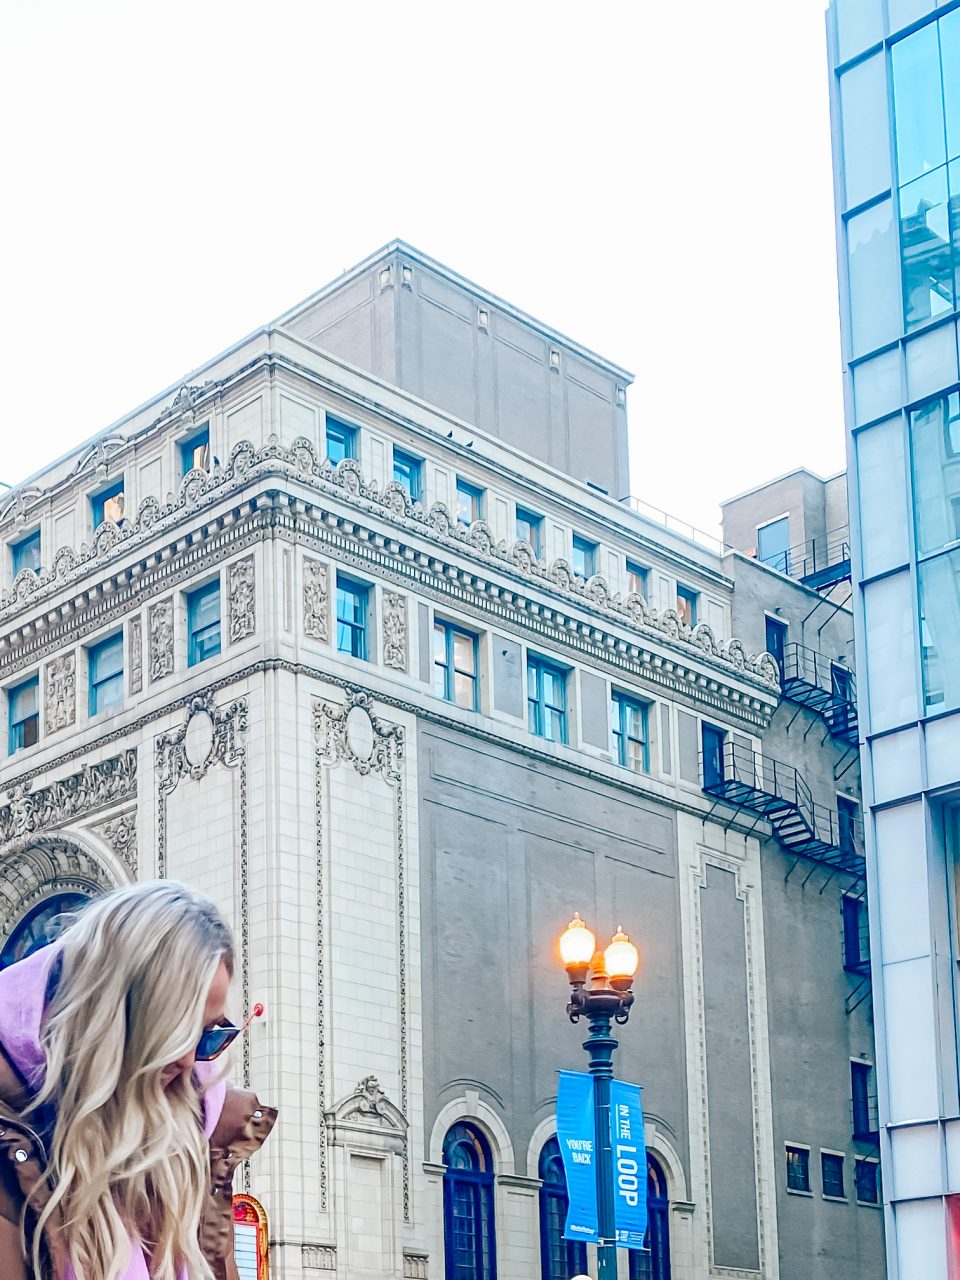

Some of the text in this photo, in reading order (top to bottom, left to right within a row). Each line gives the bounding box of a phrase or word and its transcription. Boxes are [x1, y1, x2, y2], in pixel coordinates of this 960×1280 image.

[566, 1138, 594, 1152] YOU'RE
[571, 1152, 592, 1165] BACK
[616, 1104, 639, 1207] IN THE LOOP
